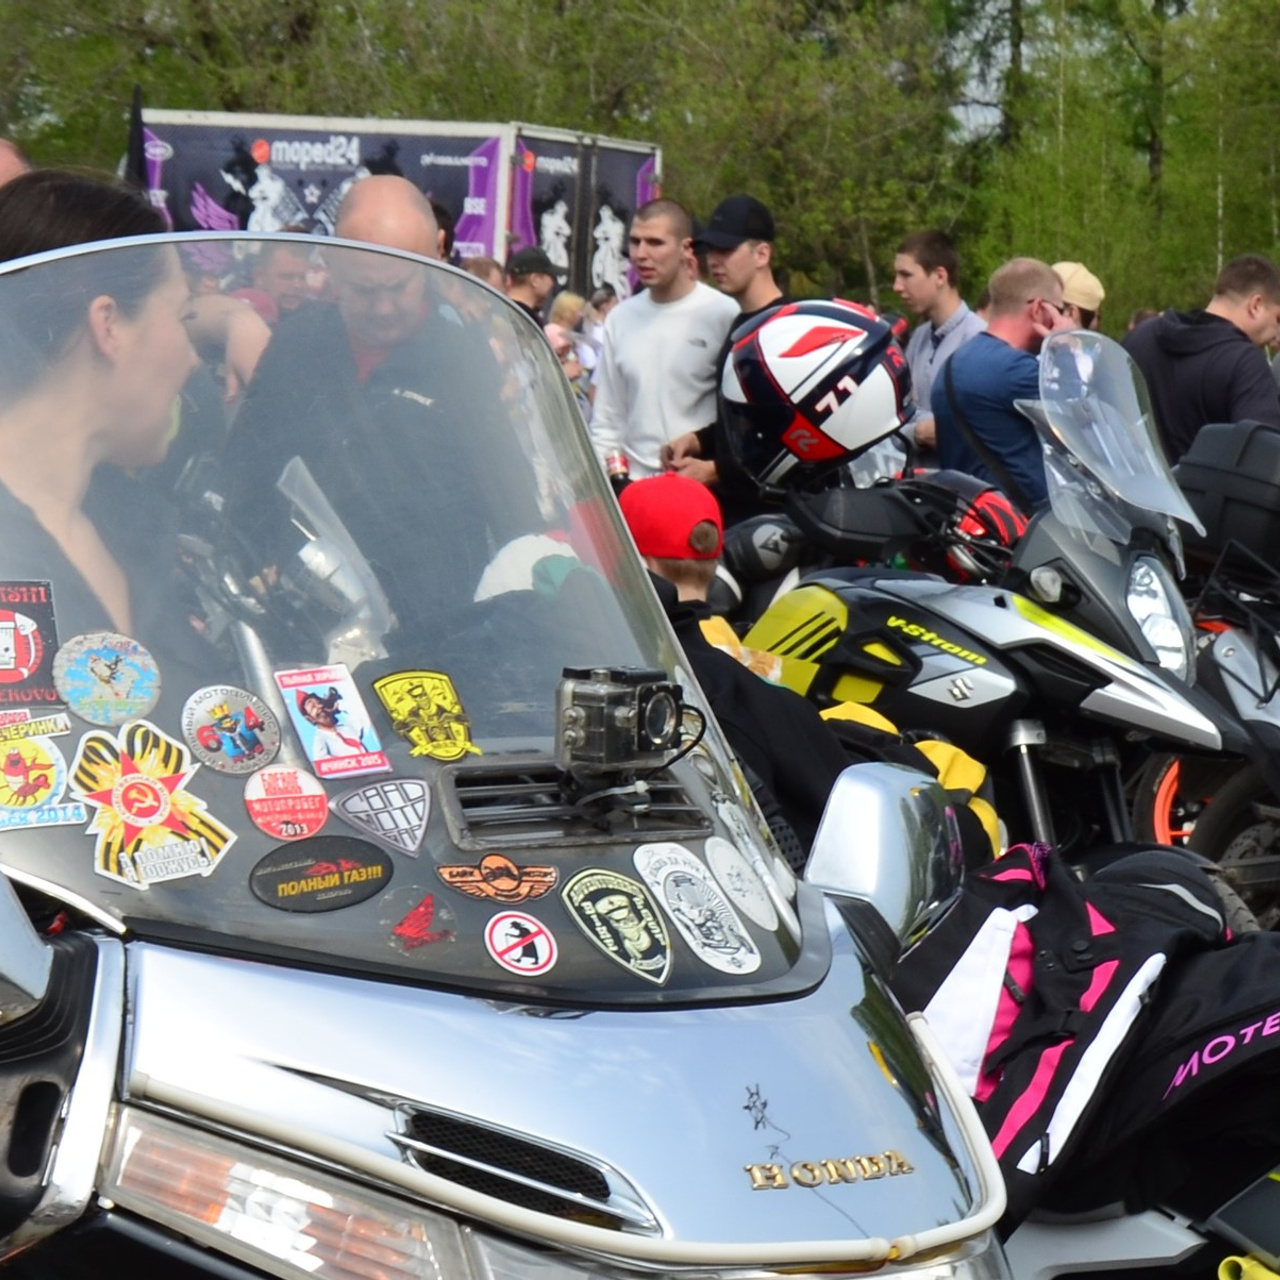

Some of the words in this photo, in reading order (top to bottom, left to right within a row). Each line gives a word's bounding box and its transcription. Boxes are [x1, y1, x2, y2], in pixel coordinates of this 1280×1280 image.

[271, 136, 359, 170] moped24
[0, 715, 70, 741] ЧЕРИНКА
[277, 872, 340, 898] ПОЛНЫЙ
[342, 865, 382, 885] ГАЗ!!!
[743, 1149, 914, 1190] HONDA
